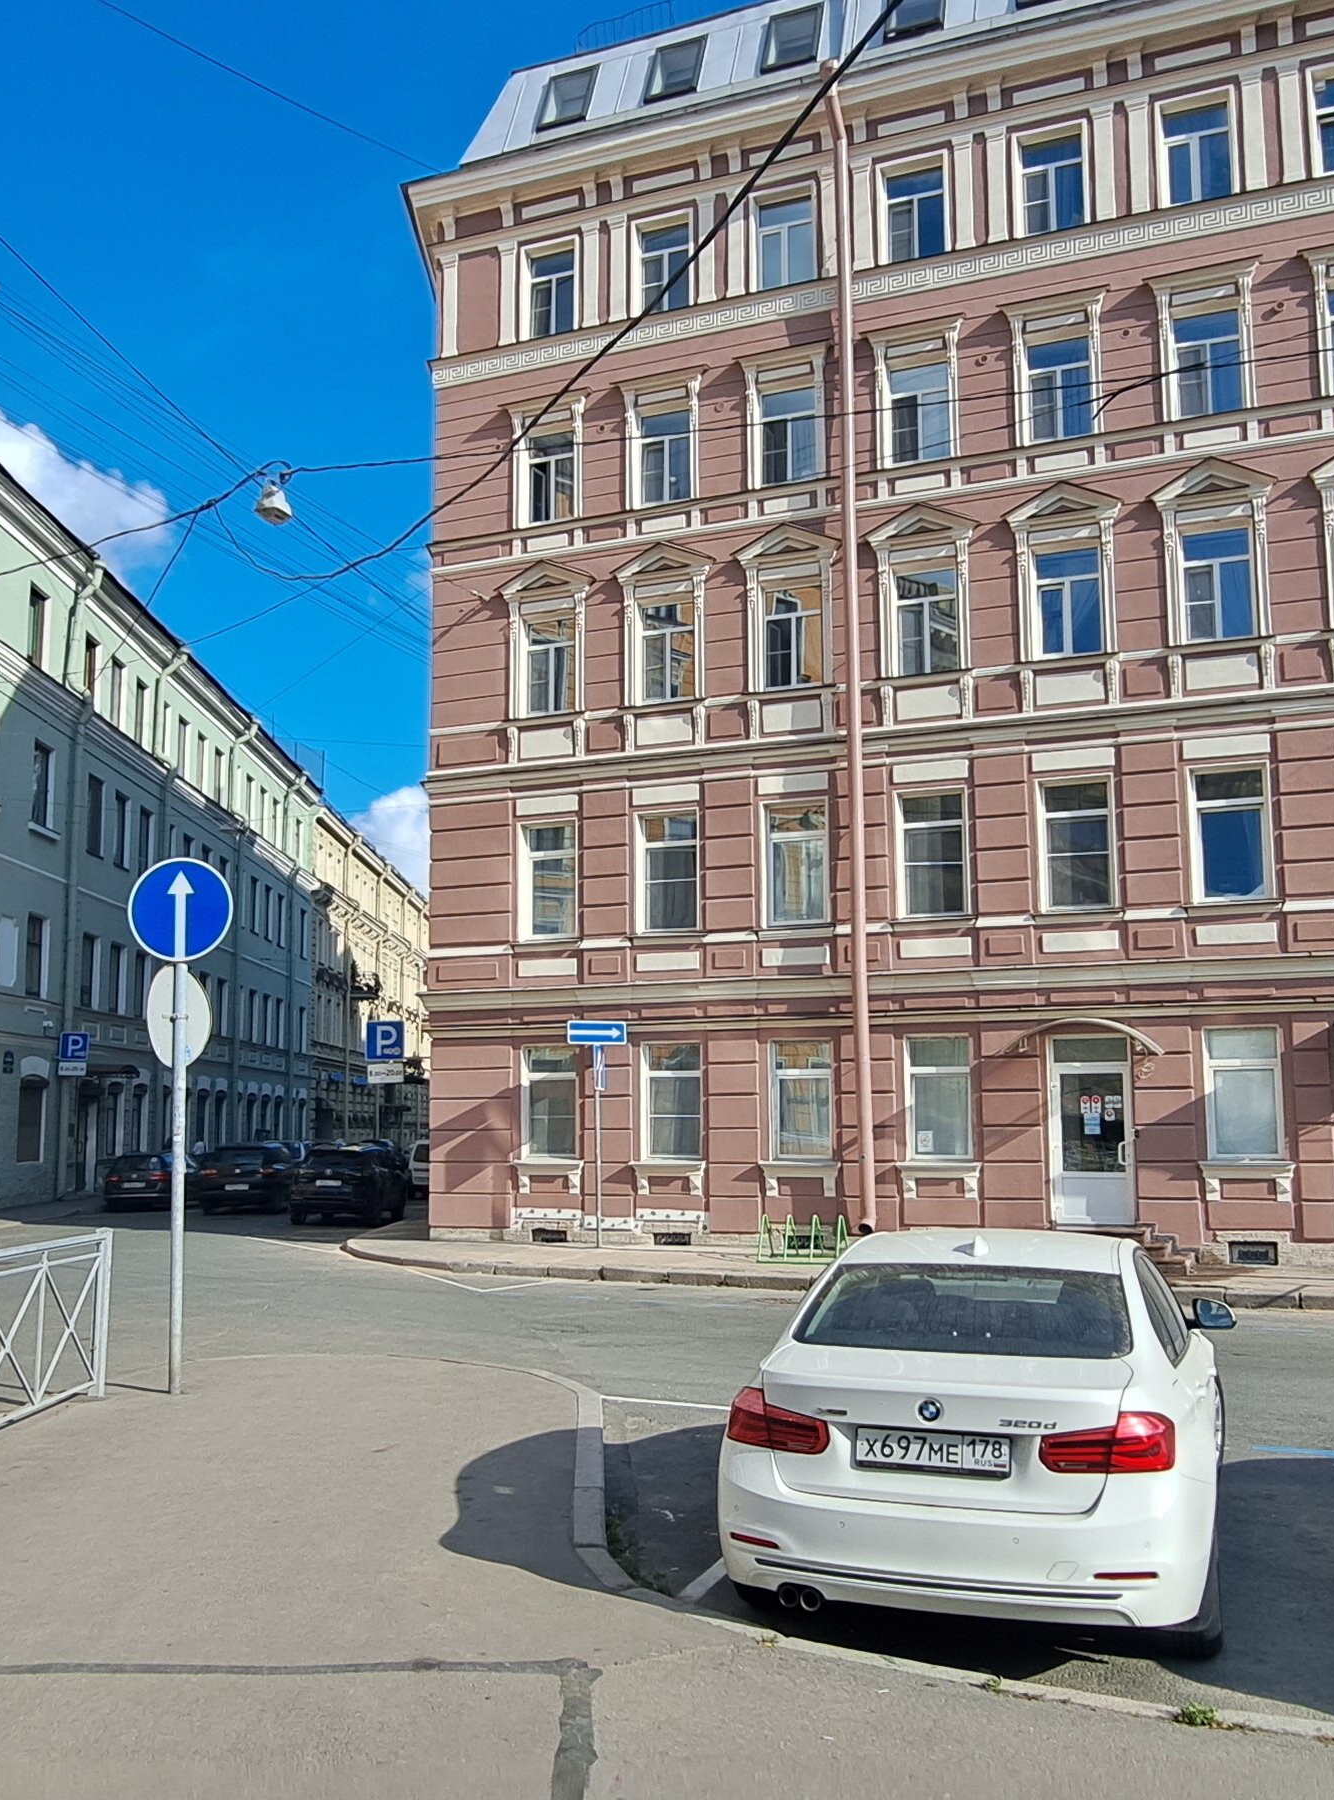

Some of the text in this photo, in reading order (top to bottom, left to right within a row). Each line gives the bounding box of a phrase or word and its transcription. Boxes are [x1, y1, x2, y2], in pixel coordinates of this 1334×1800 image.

[998, 1419, 1057, 1430] 320d
[967, 1439, 1003, 1459] 178
[974, 1458, 993, 1467] RUS
